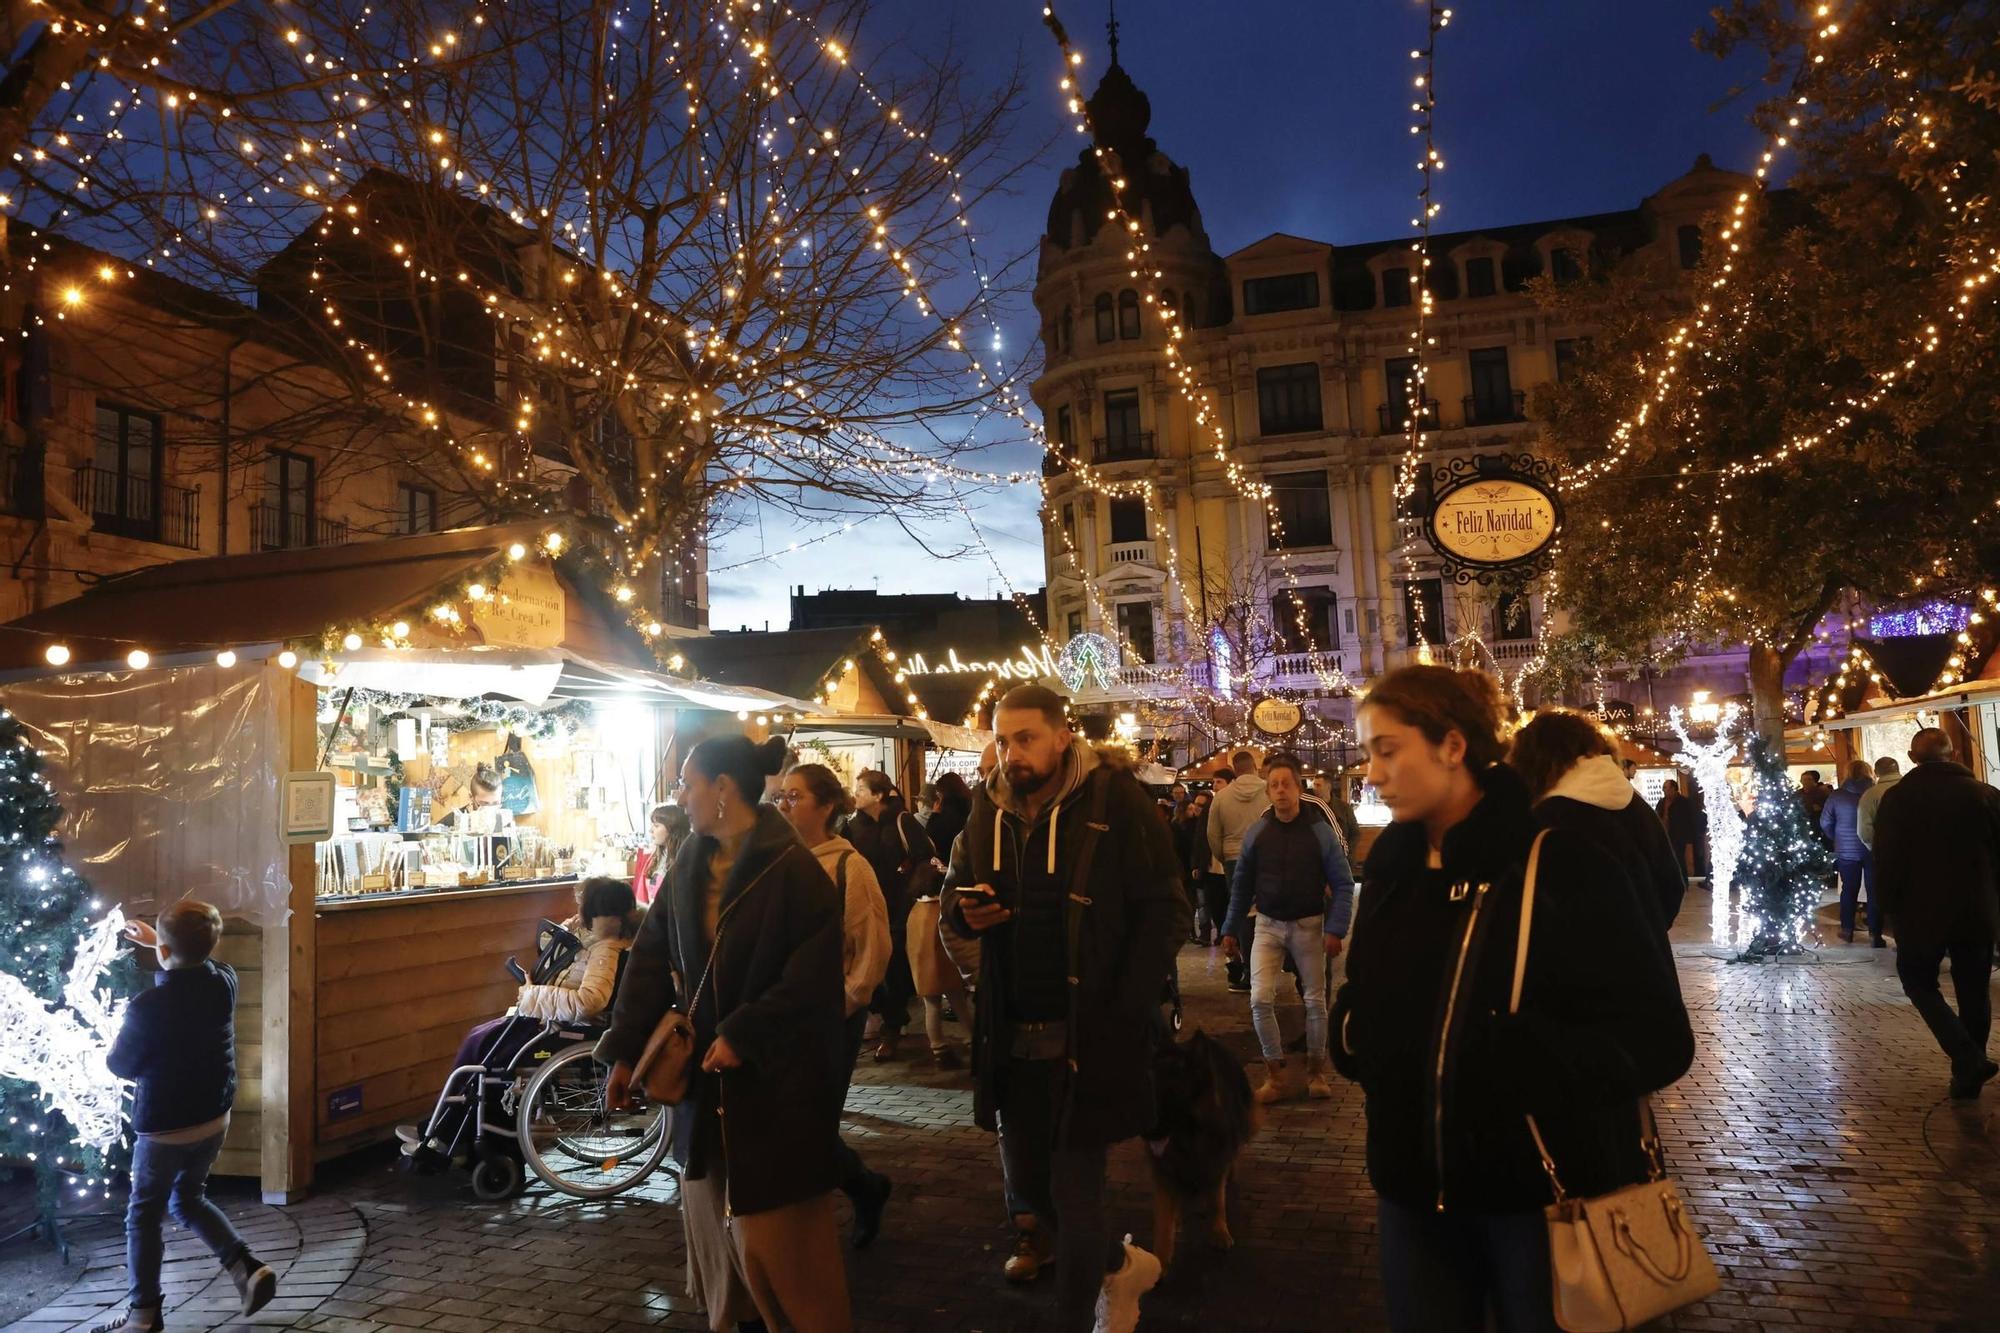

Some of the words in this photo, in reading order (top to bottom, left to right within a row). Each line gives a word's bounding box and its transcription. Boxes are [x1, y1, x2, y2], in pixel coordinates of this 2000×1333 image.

[1456, 510, 1484, 534] Feliz
[1486, 507, 1532, 532] Navidad
[1588, 709, 1626, 721] BBVA
[926, 760, 978, 768] nimals.com
